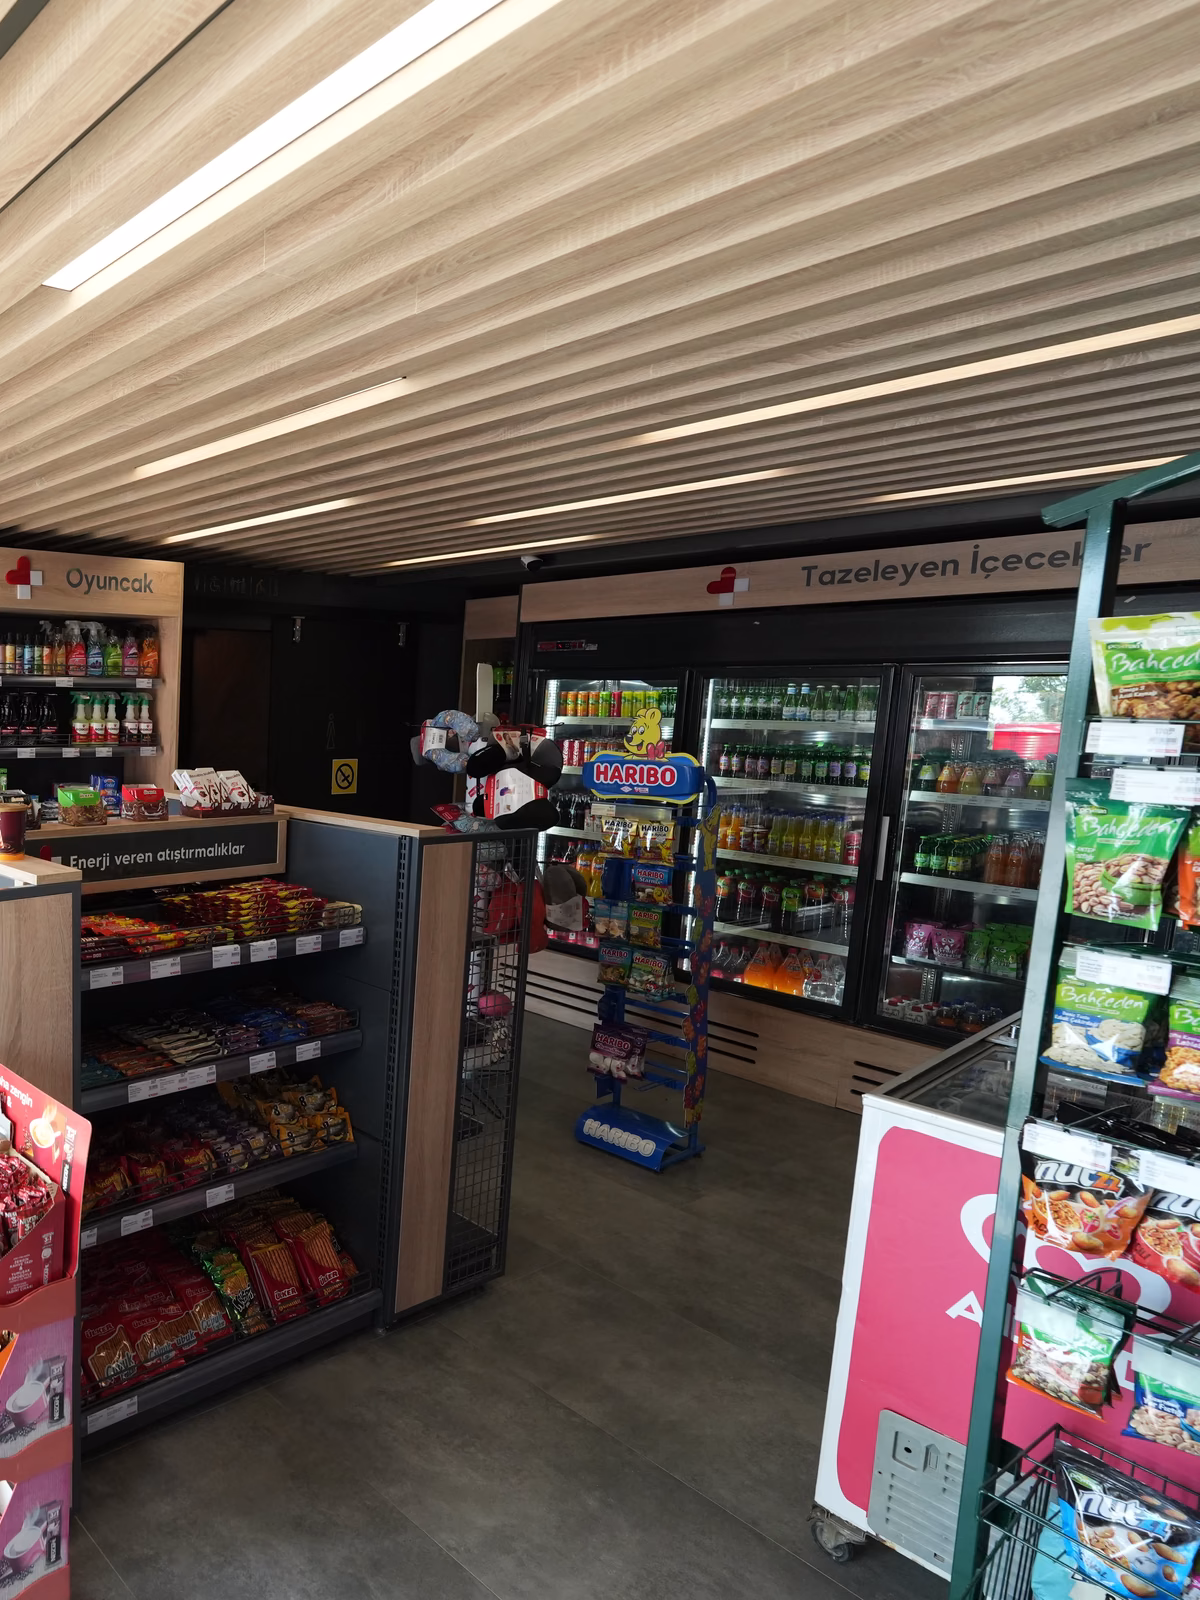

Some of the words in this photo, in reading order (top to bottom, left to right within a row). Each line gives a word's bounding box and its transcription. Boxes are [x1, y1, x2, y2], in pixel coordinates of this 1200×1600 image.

[802, 558, 960, 587] Tazeleyen
[970, 540, 1152, 579] İçeceker
[65, 566, 155, 595] Oyuncak
[593, 763, 677, 787] HARIBO
[604, 819, 634, 829] HARIBO
[640, 823, 670, 834] HARIBO
[69, 854, 111, 871] Enerji
[114, 849, 154, 866] veren
[156, 841, 246, 864] atıştırmalıklar
[636, 869, 665, 880] HARIBO
[632, 909, 660, 921] HARIBO
[601, 947, 629, 959] HARIBO
[633, 955, 664, 969] HARIBO
[1060, 985, 1145, 1010] Bahçeden
[595, 1032, 632, 1051] HARIBO
[582, 1117, 657, 1158] HARIBO
[274, 1286, 299, 1301] ÜLKER
